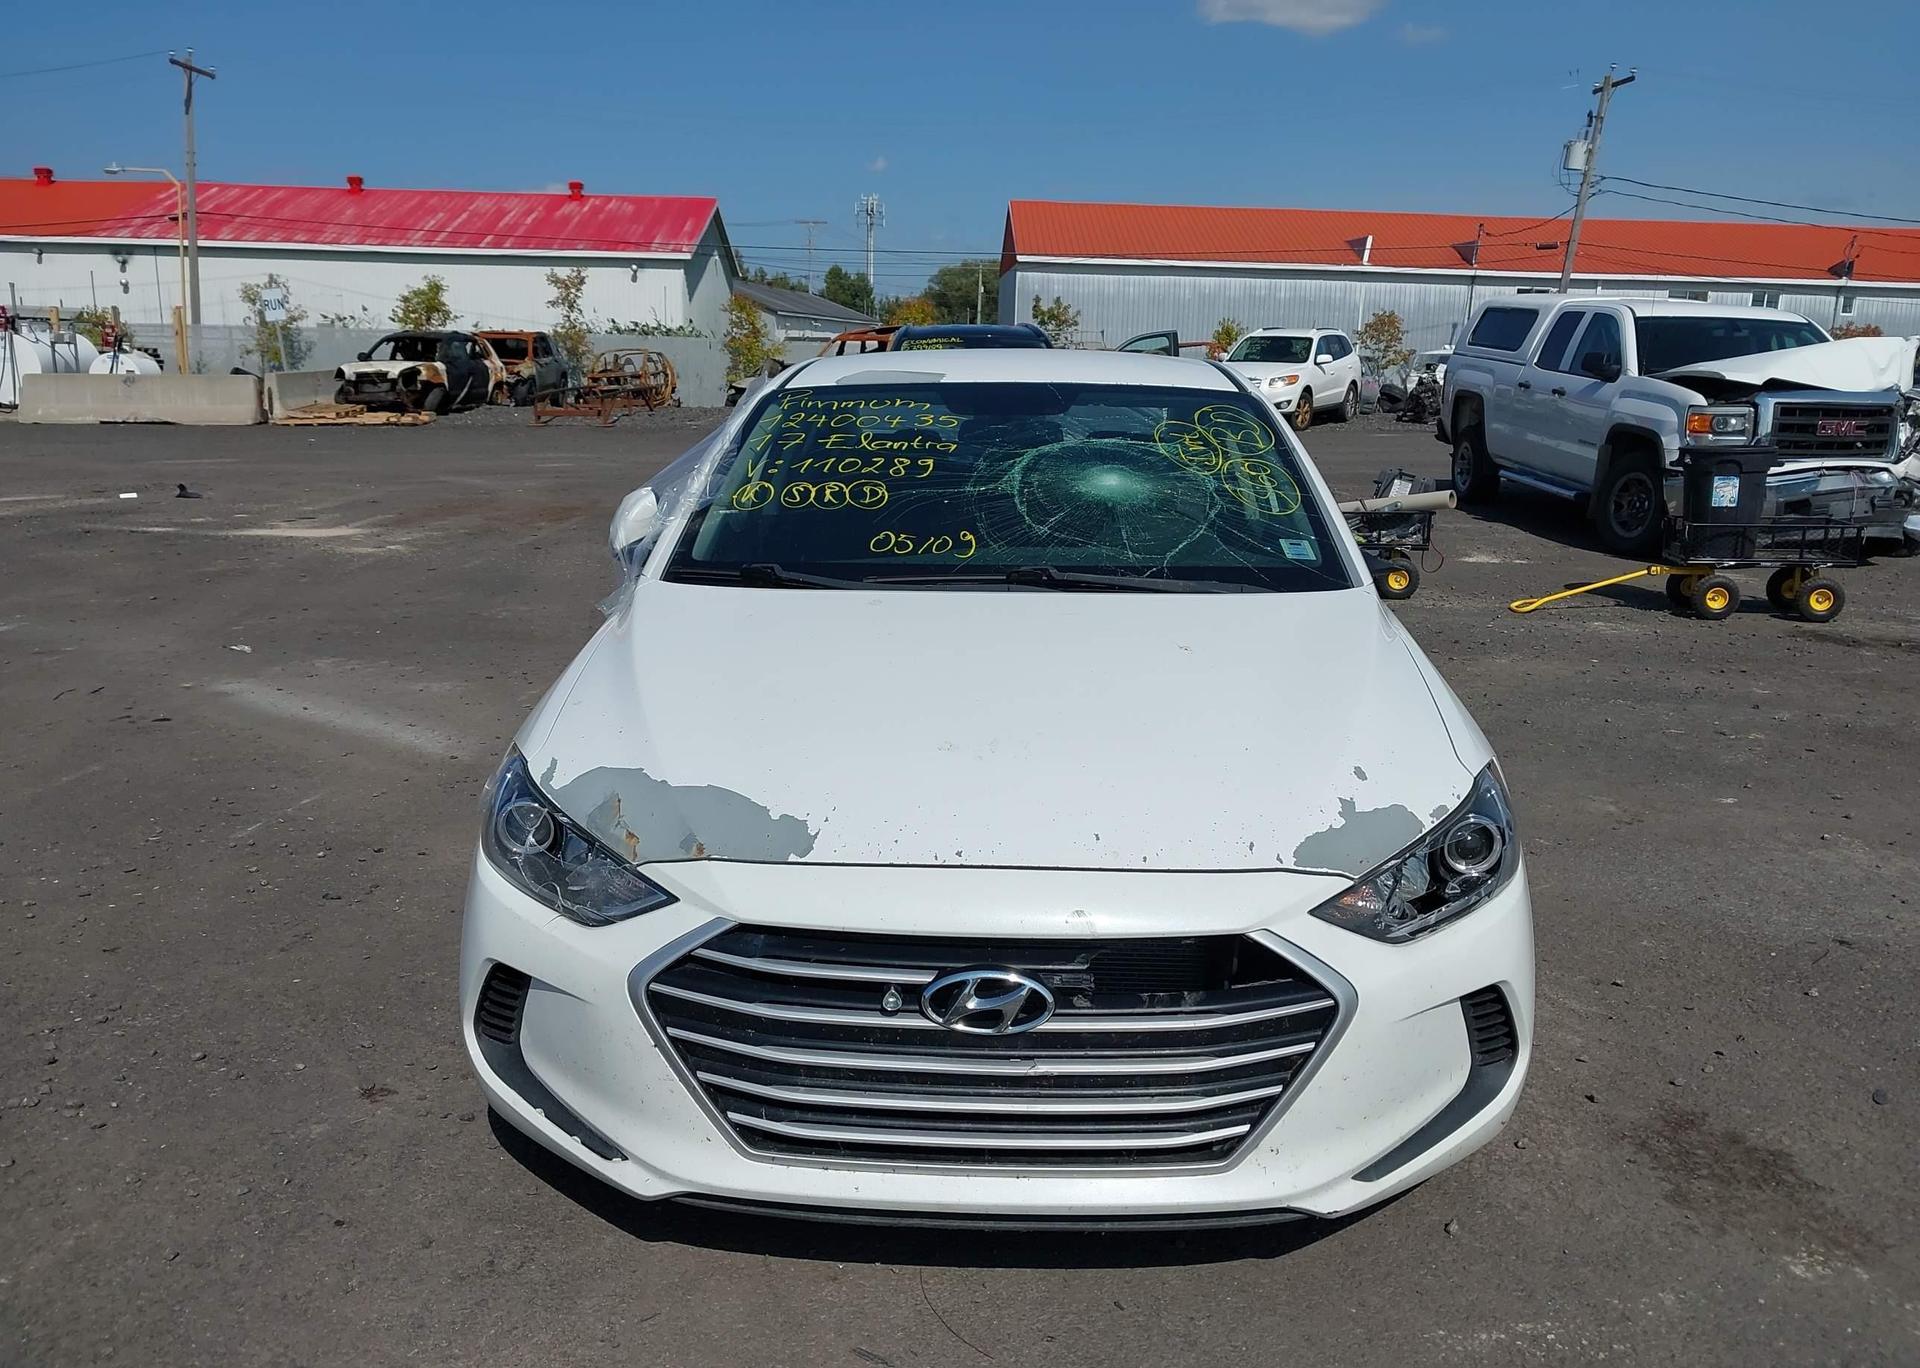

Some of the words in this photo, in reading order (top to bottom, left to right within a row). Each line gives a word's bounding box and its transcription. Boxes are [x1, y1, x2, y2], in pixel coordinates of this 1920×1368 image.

[264, 299, 285, 311] RUN
[760, 412, 969, 429] 12400435
[1816, 420, 1869, 436] GMC
[750, 432, 806, 451] 17
[818, 431, 959, 453] Elantra
[790, 457, 935, 478] 110289
